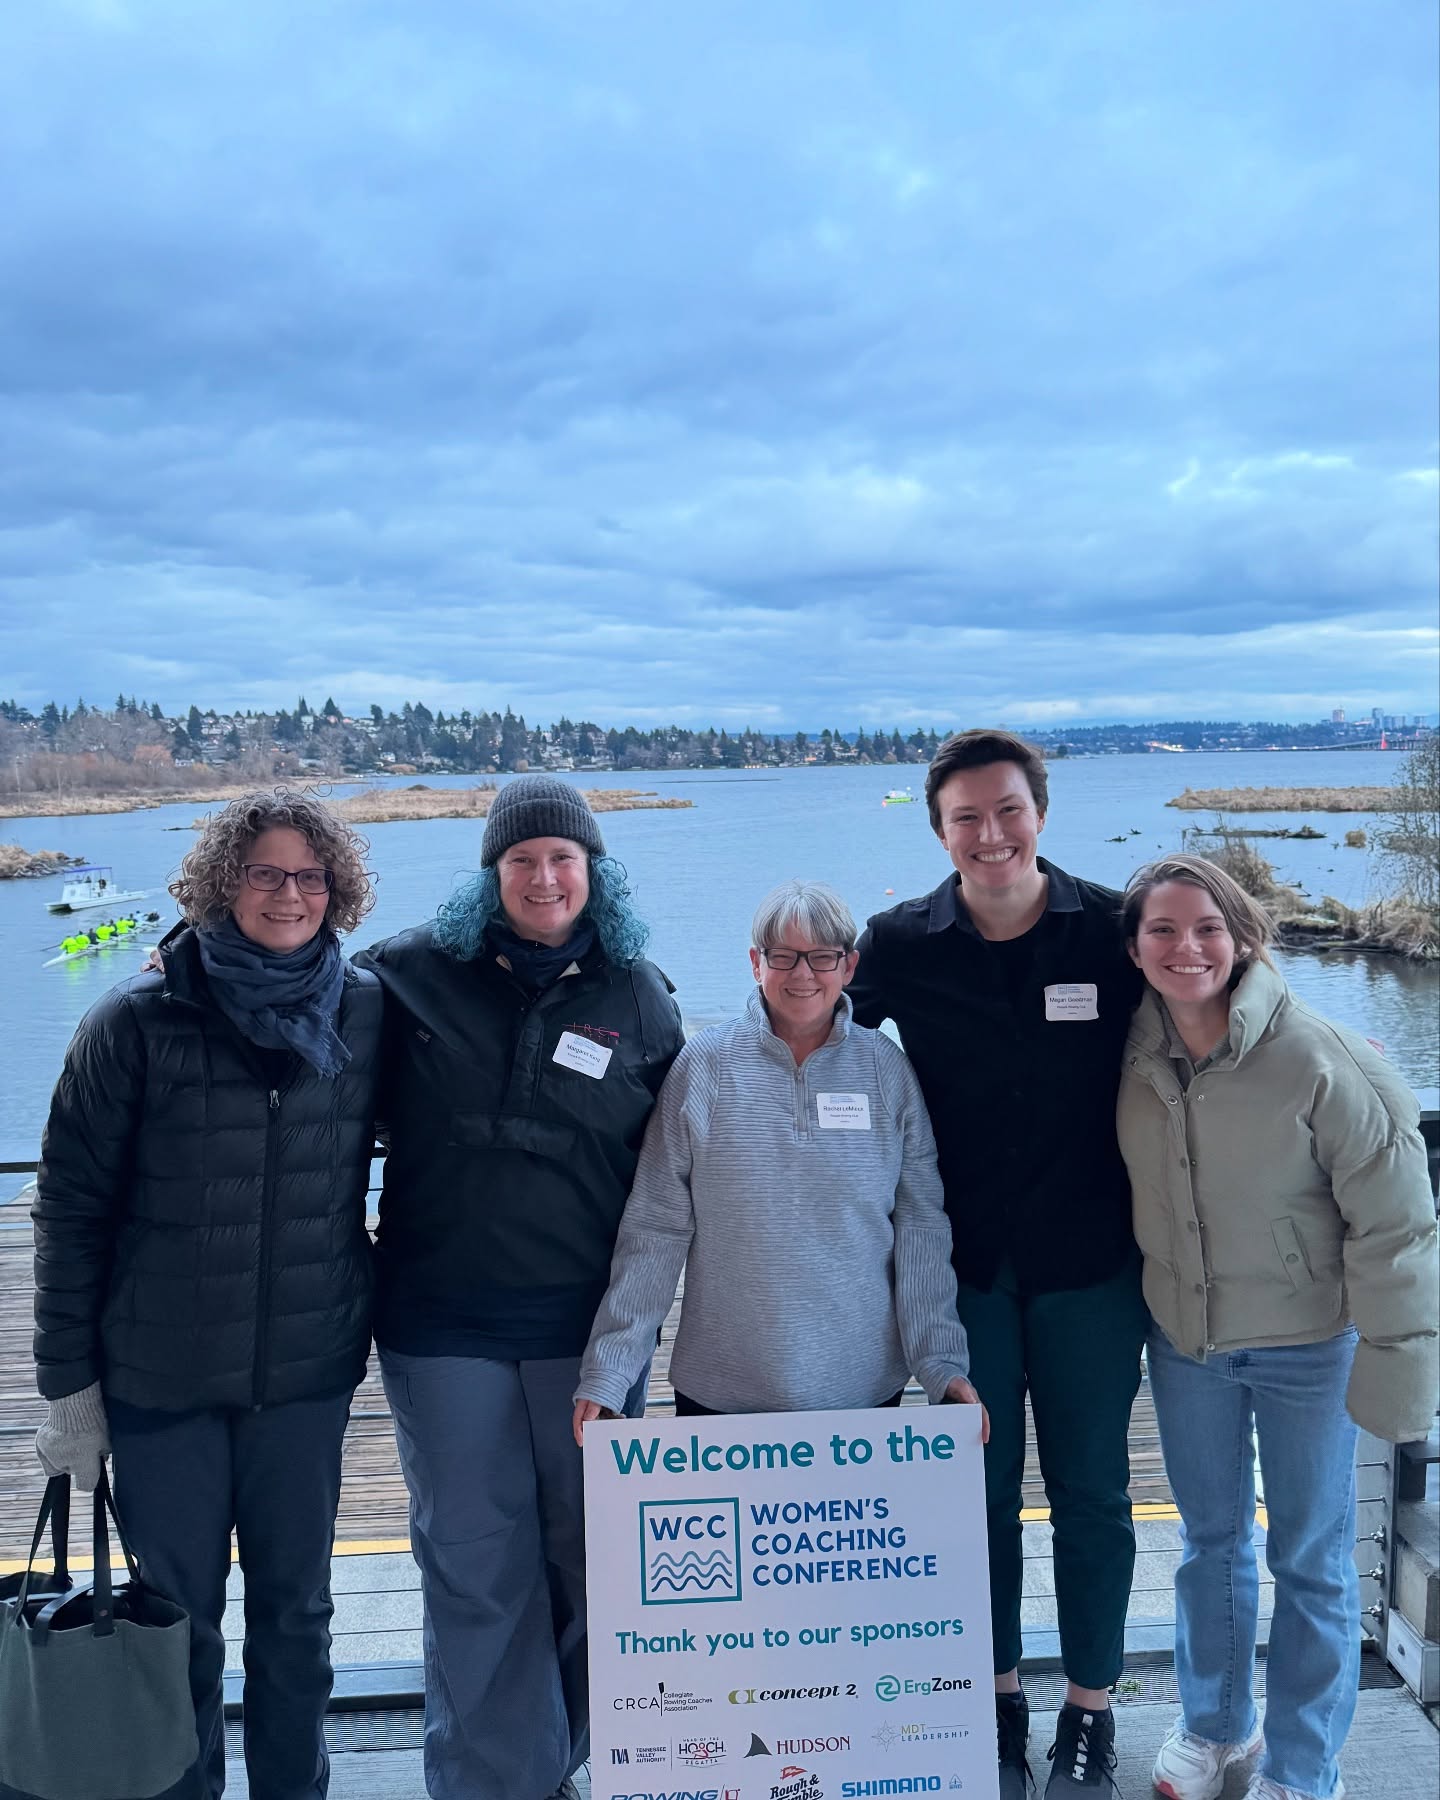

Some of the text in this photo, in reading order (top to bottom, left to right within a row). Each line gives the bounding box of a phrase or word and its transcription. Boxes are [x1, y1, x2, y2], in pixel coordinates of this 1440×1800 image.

[566, 1044, 589, 1056] Margaret
[590, 1054, 600, 1063] King
[611, 1425, 955, 1474] Welcome to the
[750, 1498, 889, 1525] WOMEN'S
[649, 1515, 727, 1541] WCC
[752, 1527, 906, 1556] COACHING
[753, 1553, 937, 1586] CONFERENCE
[615, 1619, 963, 1656] Thank you to our sponsors
[760, 1684, 857, 1701] concept 2
[905, 1677, 971, 1695] ErgZone
[614, 1697, 660, 1710] CRCA
[901, 1724, 926, 1734] MDT
[902, 1731, 969, 1741] LEADERSHIP
[777, 1736, 850, 1754] HUDSON
[610, 1749, 629, 1764] TVA
[770, 1773, 820, 1800] Rough &
[842, 1776, 941, 1797] SHIMANO
